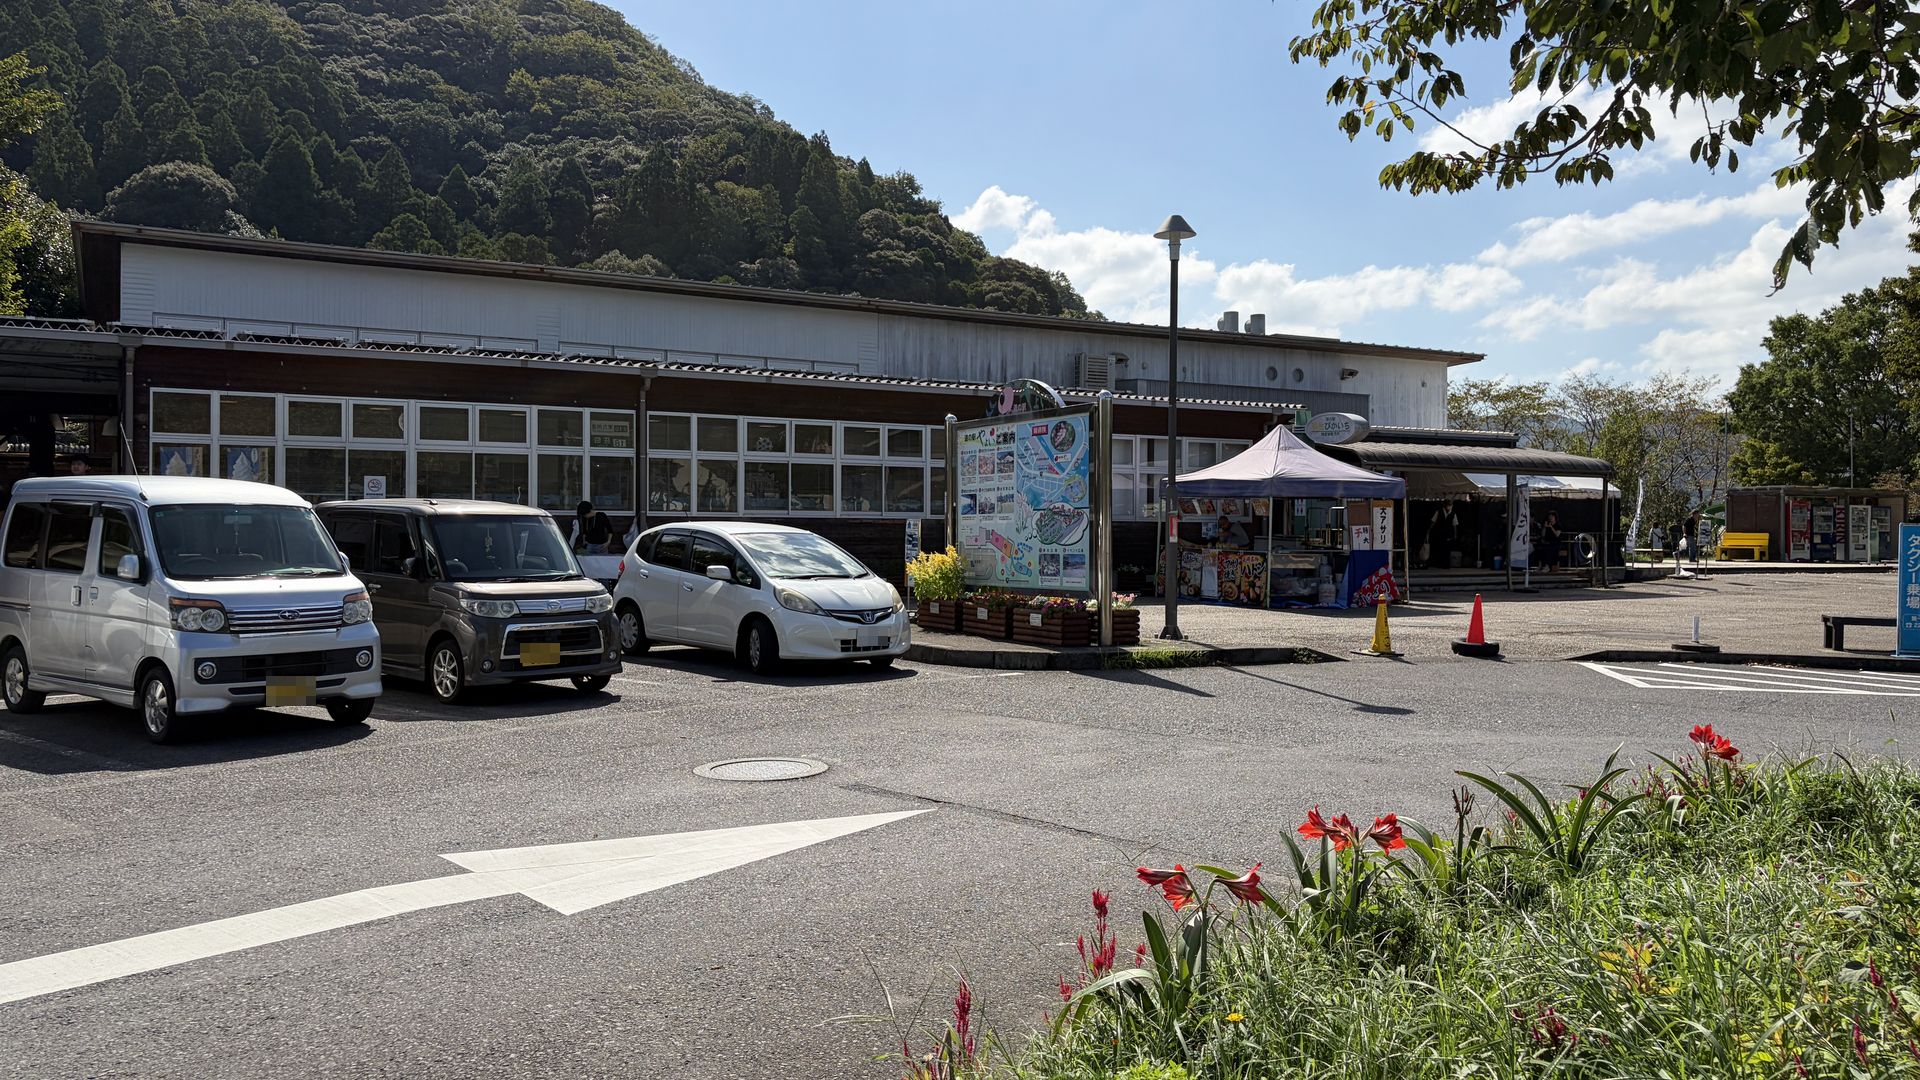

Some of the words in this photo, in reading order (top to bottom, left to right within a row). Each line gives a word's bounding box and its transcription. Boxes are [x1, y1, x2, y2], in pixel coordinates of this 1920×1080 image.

[996, 431, 1016, 445] ご案内
[1379, 507, 1387, 544] 大アサリ
[1836, 507, 1846, 544] KIRIN
[1906, 534, 1920, 609] タクシー乗場
